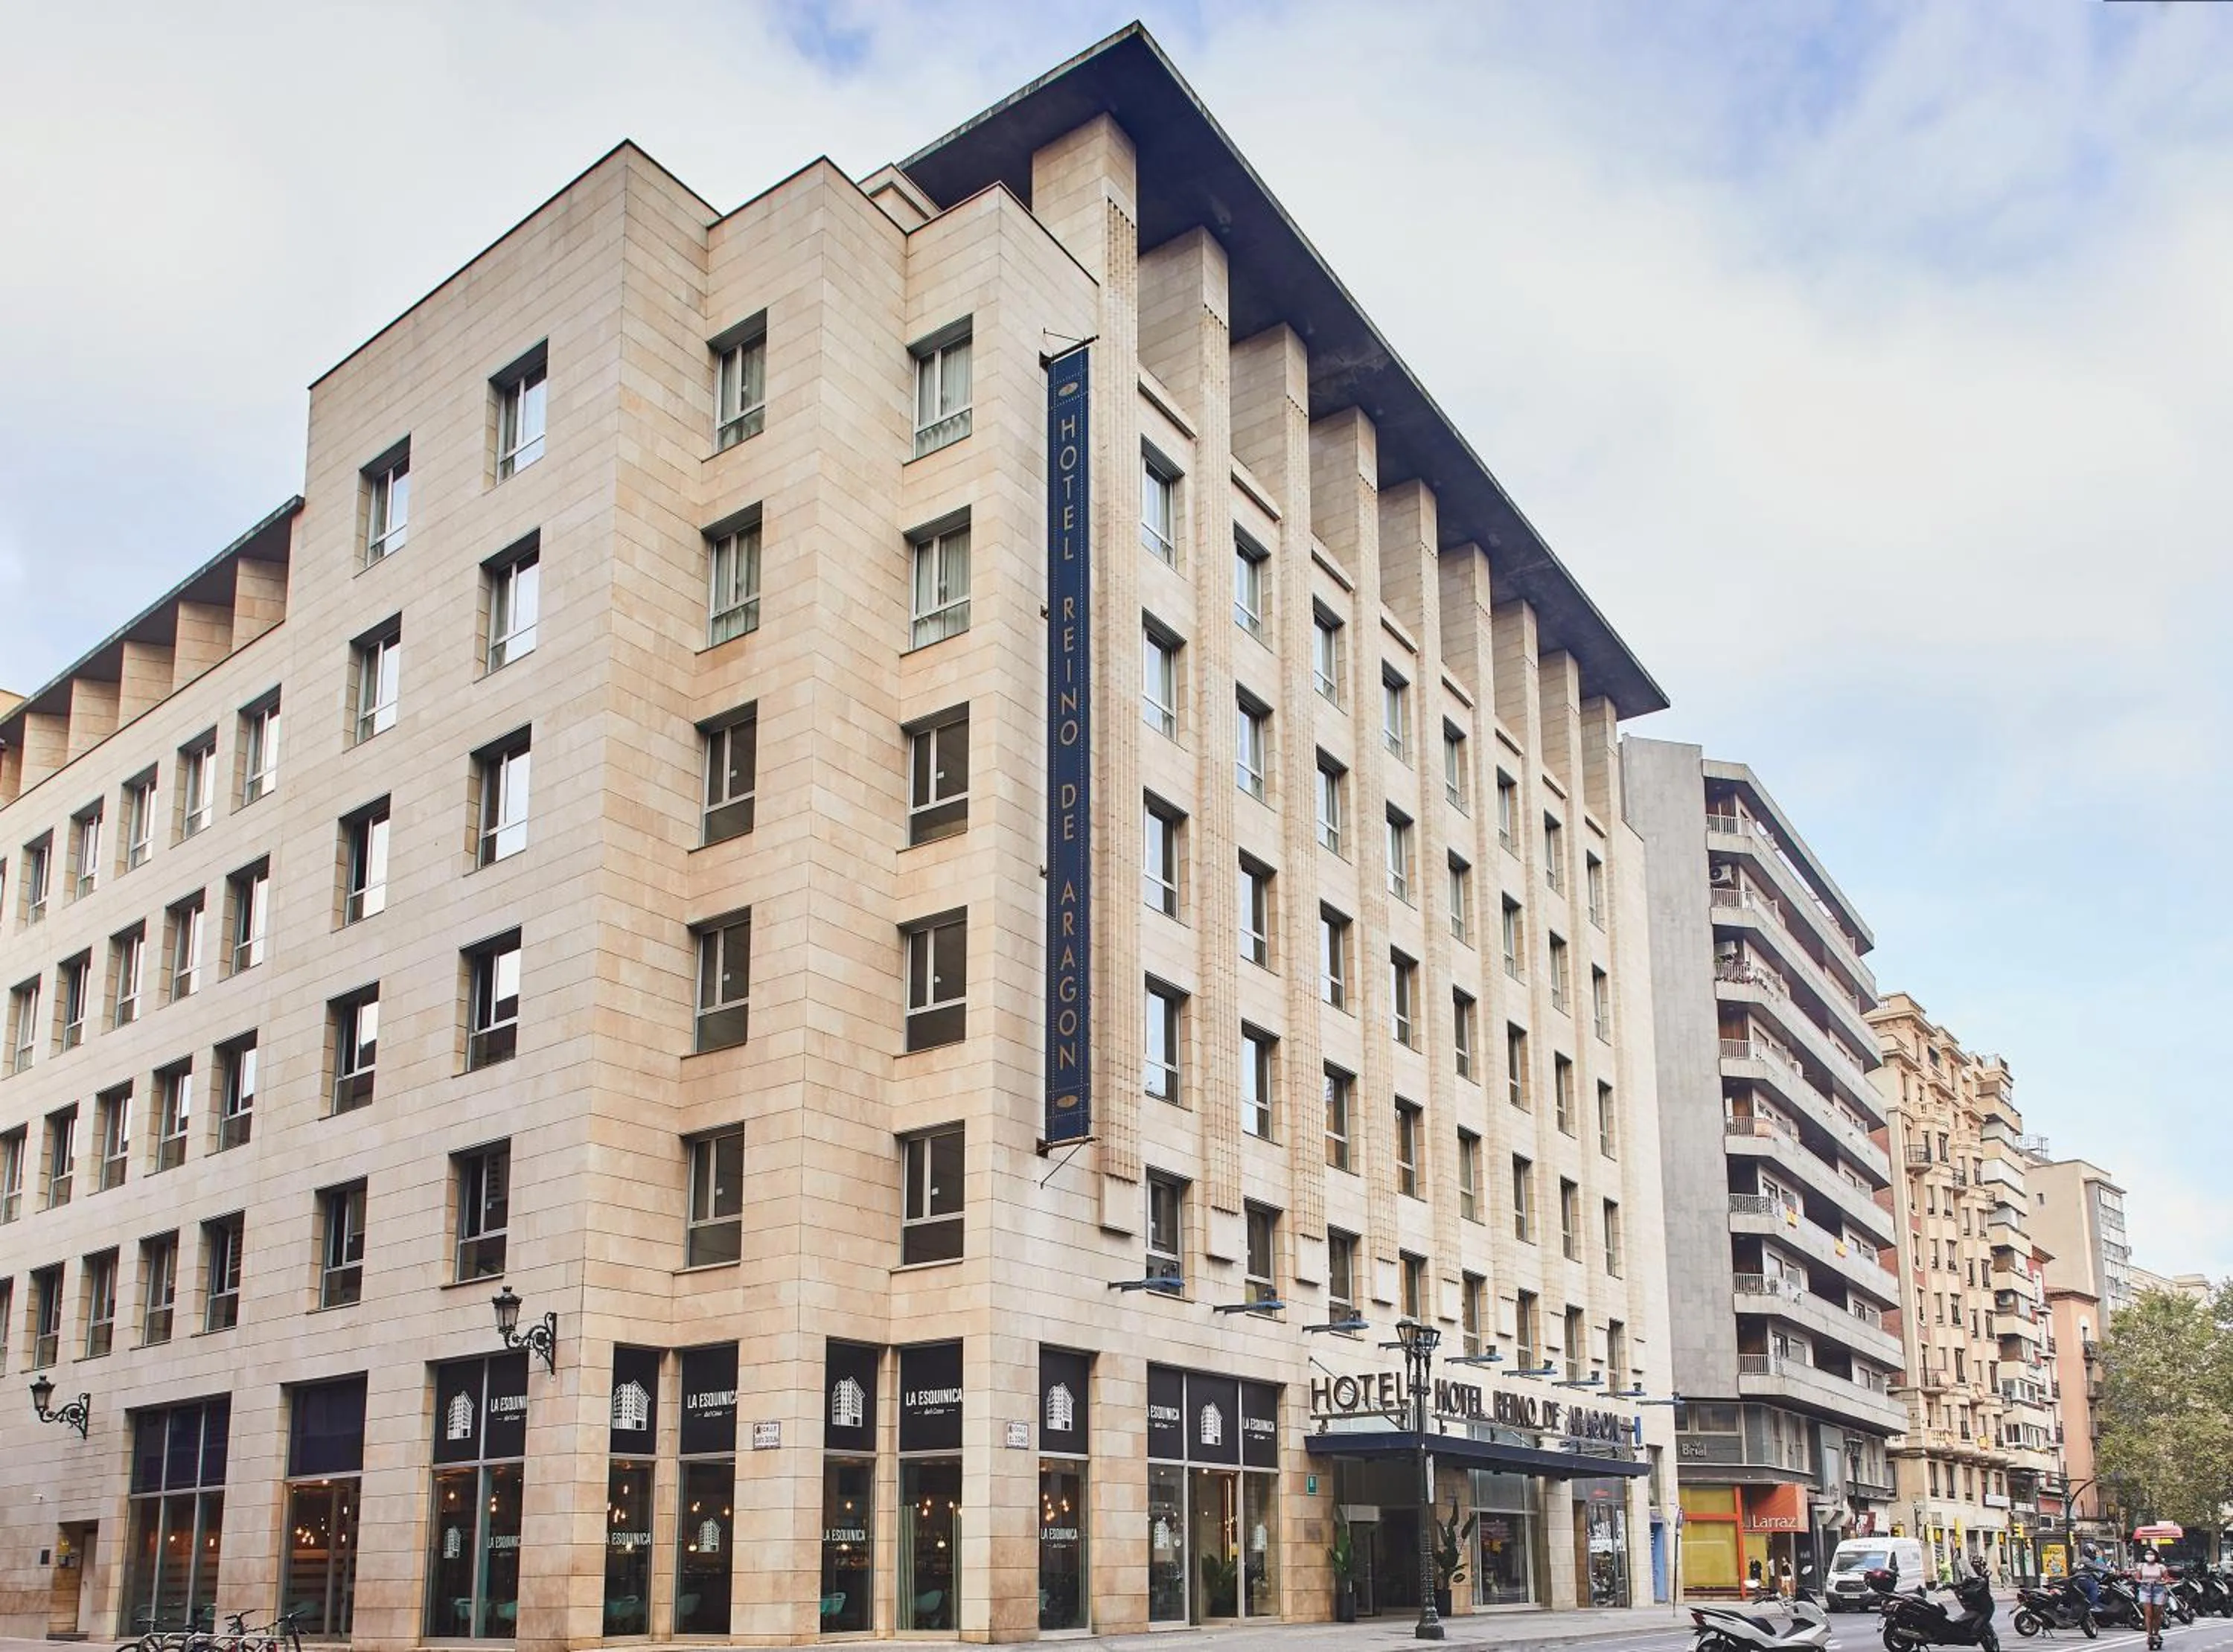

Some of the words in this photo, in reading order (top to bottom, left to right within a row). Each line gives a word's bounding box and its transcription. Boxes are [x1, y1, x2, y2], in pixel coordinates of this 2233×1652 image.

[1059, 414, 1078, 560] HOTEL
[1059, 596, 1079, 746] REINO
[1061, 784, 1076, 841] DE
[1059, 880, 1078, 1072] ARAGON
[687, 1394, 697, 1409] LA
[906, 1391, 916, 1406] LA
[918, 1388, 962, 1406] ESQUINICA
[1311, 1371, 1411, 1410] HOTEL
[1434, 1378, 1482, 1419] HOTEL
[1542, 1400, 1560, 1430] DE
[1752, 1514, 1797, 1528] Larraz
